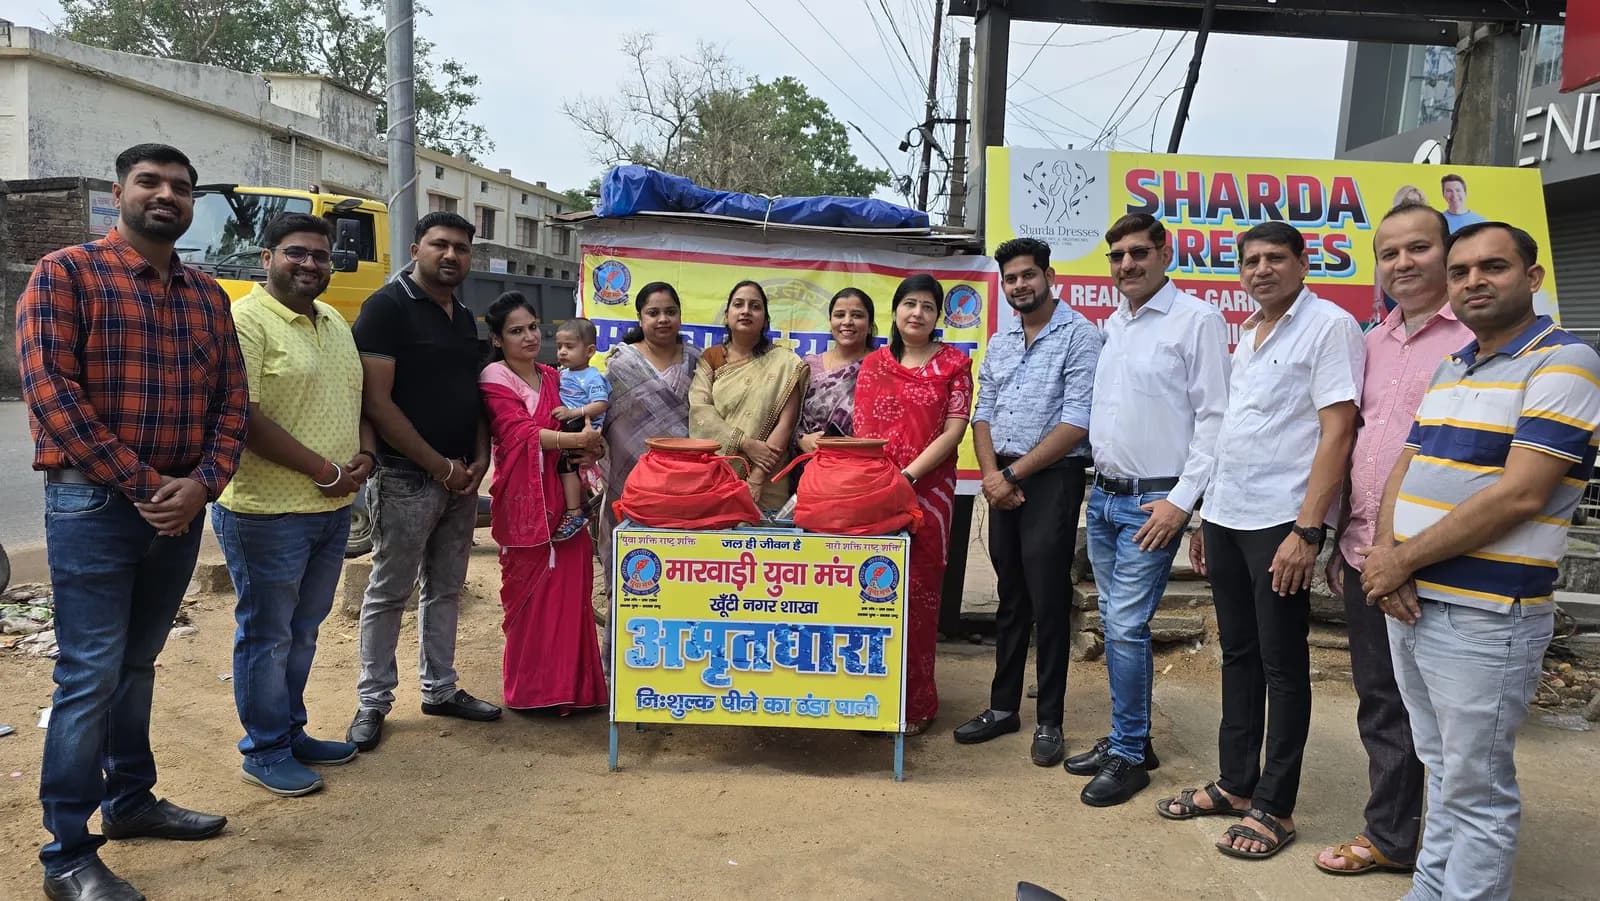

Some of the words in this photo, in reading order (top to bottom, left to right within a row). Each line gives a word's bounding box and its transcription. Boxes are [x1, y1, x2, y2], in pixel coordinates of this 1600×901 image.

[1125, 168, 1371, 230] SHARDA
[1020, 224, 1054, 236] Sharda
[1058, 225, 1100, 237] Dresses
[1165, 228, 1355, 279] REES
[622, 535, 636, 546] युवा
[638, 534, 658, 545] शक्ति
[677, 535, 697, 546] शक्ति
[721, 539, 743, 550] जल
[745, 536, 757, 550] ही
[760, 537, 792, 551] जीवन
[793, 537, 802, 551] है
[842, 540, 862, 551] शक्ति
[881, 542, 902, 553] शक्ति
[666, 552, 757, 591] मारवाड़ी
[763, 561, 808, 598] युवा
[814, 555, 856, 588] मंच
[709, 593, 739, 618] खूँटी
[743, 599, 777, 614] नगर
[780, 600, 819, 615] शाखा
[625, 619, 892, 686] अमृतधारा
[636, 687, 716, 718] निःशुल्क
[720, 689, 760, 715] पीने
[763, 696, 792, 716] का
[795, 692, 832, 717] ठंडा
[835, 693, 880, 718] पानी
